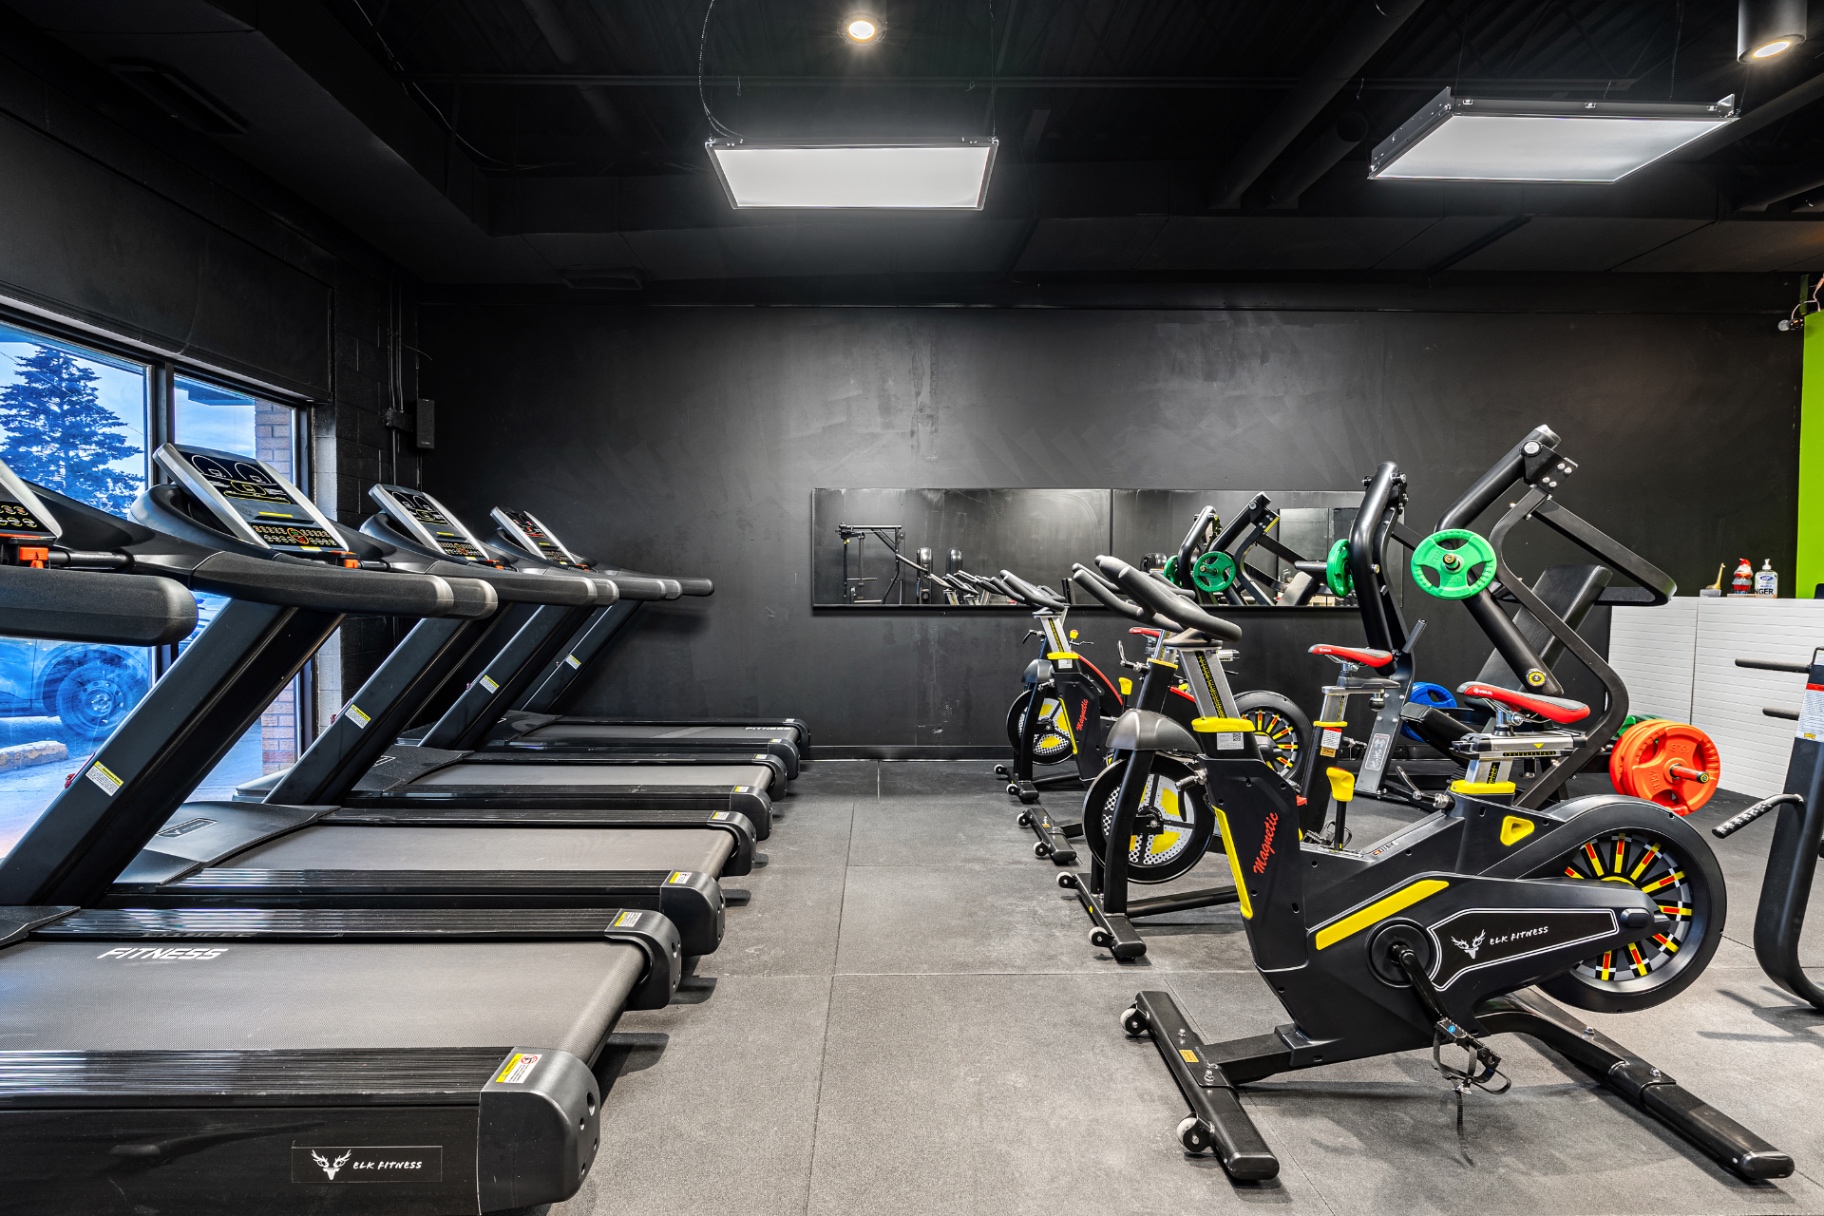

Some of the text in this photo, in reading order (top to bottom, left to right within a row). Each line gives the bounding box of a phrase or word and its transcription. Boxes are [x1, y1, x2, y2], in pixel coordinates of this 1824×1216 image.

[1076, 698, 1089, 731] Magnetic
[1253, 812, 1279, 874] Magnetic
[1489, 926, 1549, 946] ELK FITNESS
[97, 947, 229, 960] FITNESS
[353, 1161, 423, 1170] ELK FITNESS
